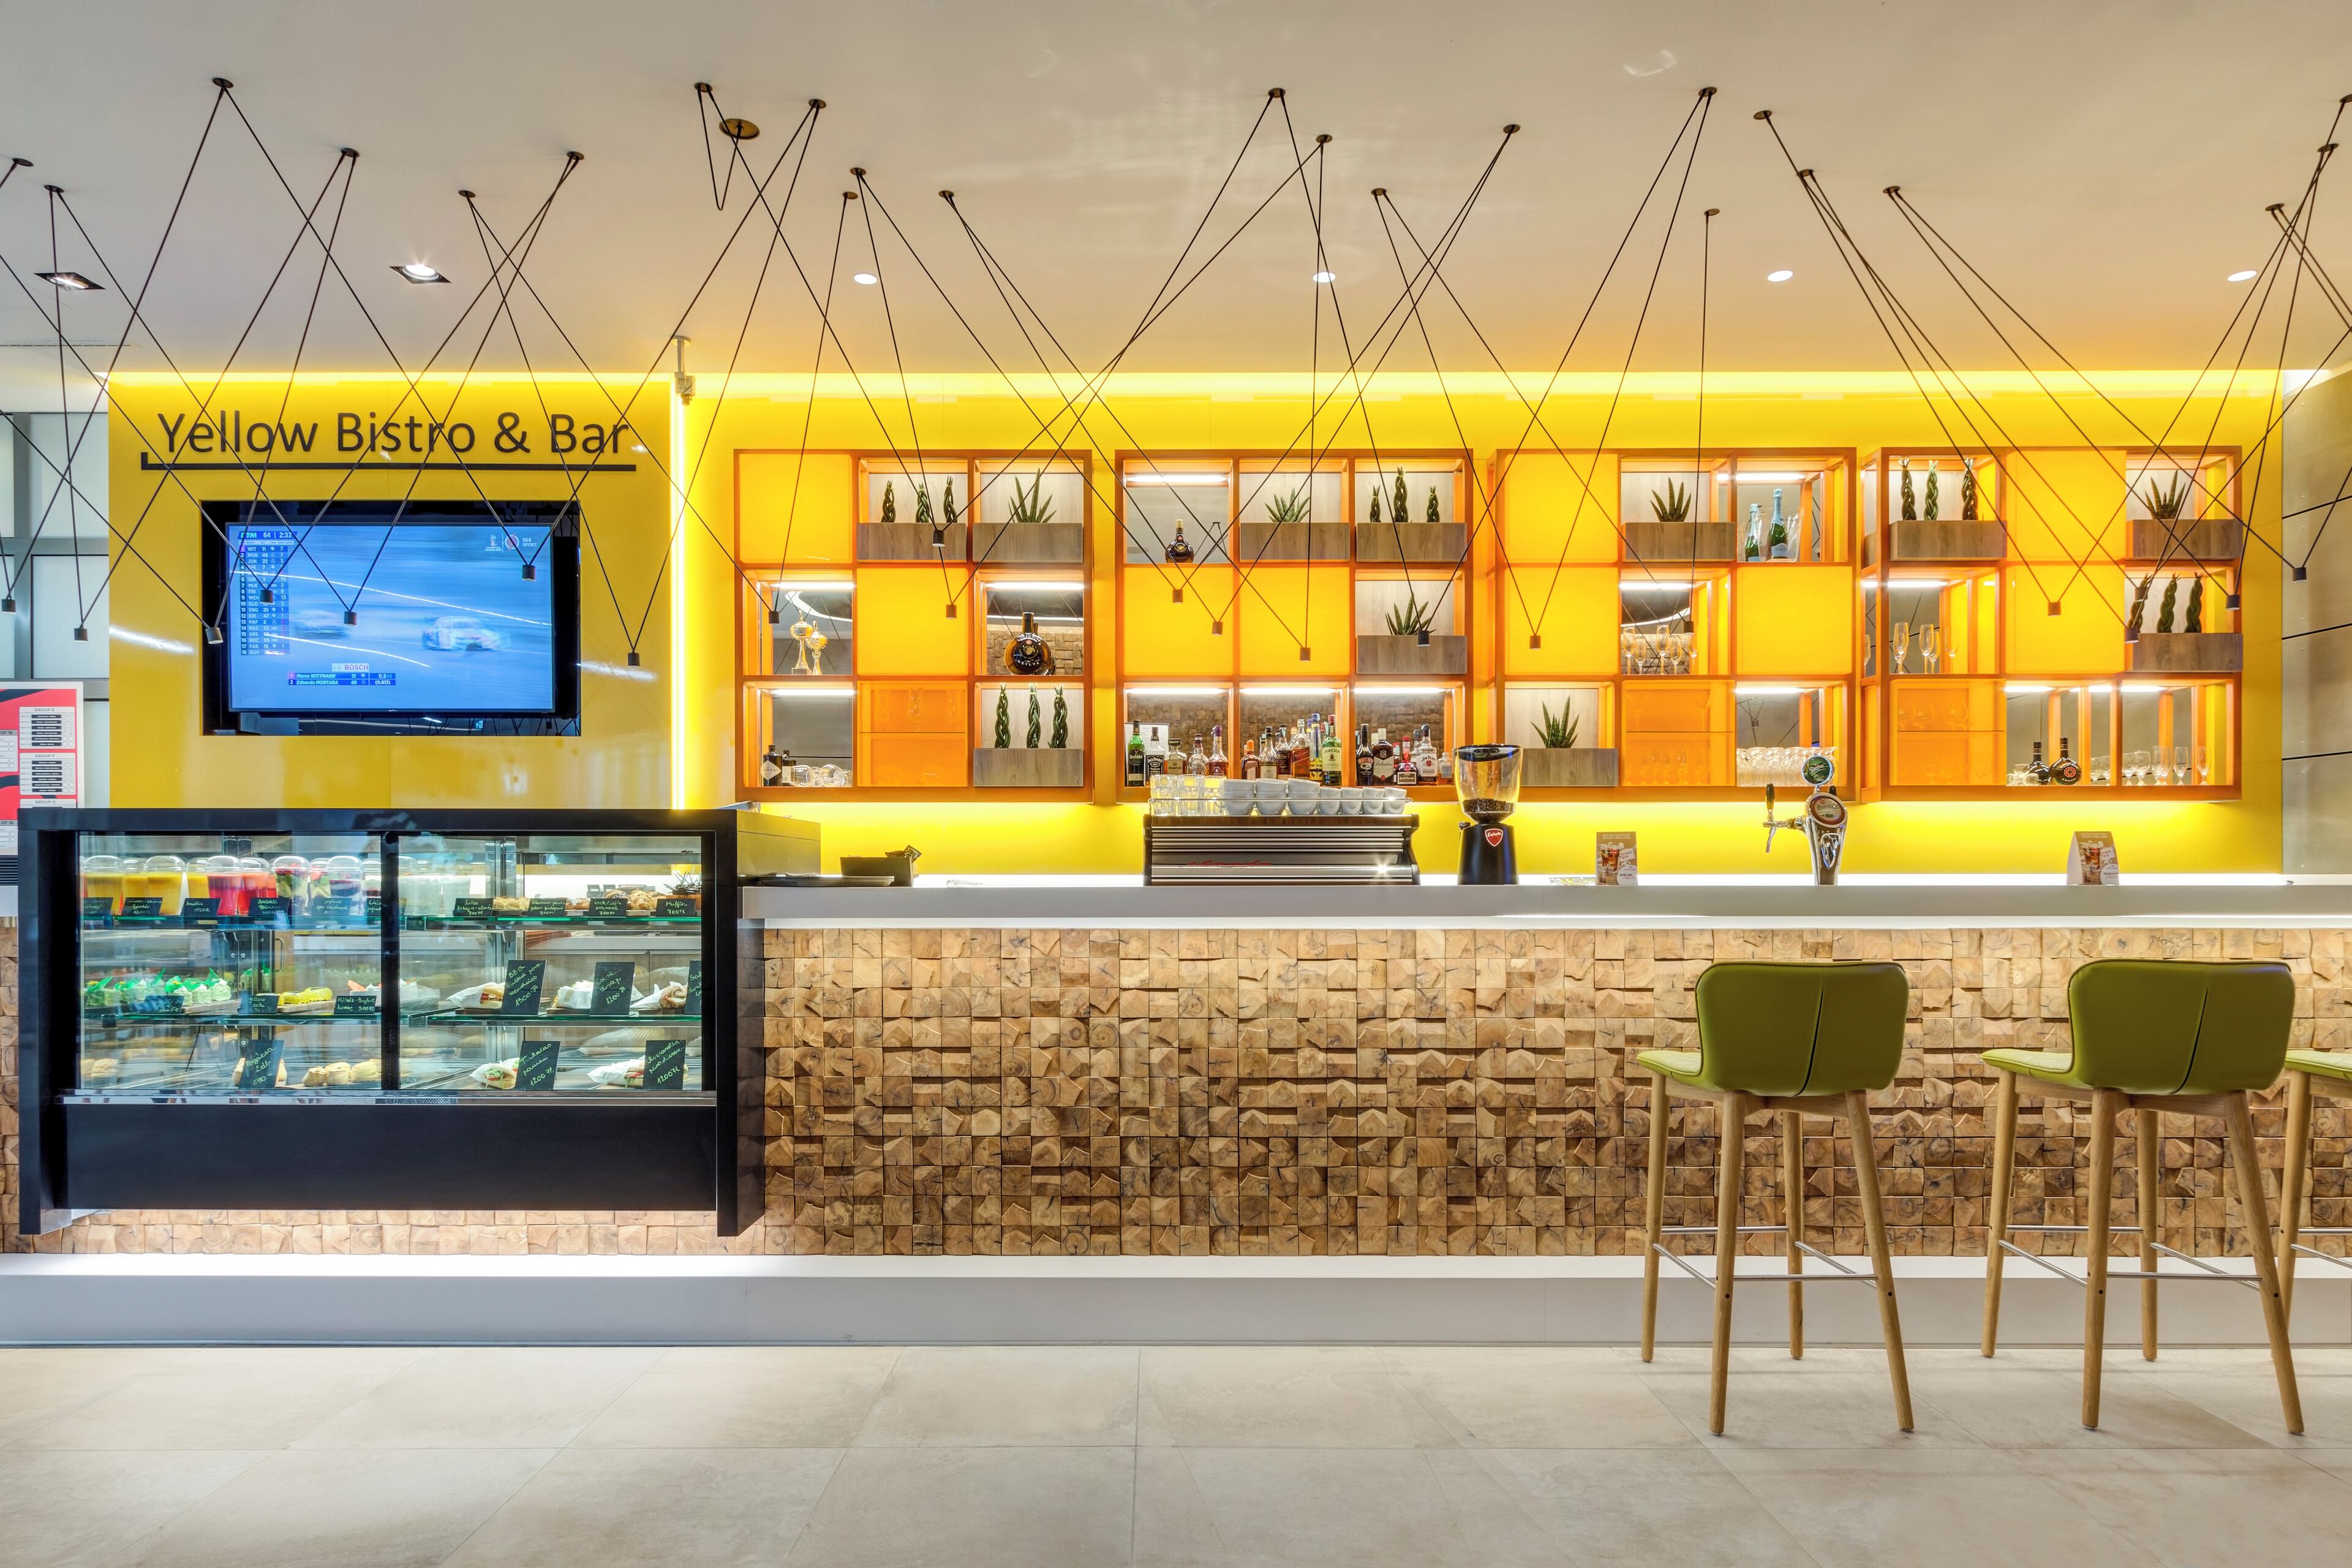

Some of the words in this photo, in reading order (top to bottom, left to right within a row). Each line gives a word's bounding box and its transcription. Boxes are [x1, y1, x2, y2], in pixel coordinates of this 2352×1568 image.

[157, 410, 318, 453] Yellow
[337, 411, 475, 453] Bistro
[494, 412, 531, 453] &
[551, 413, 629, 454] Bar
